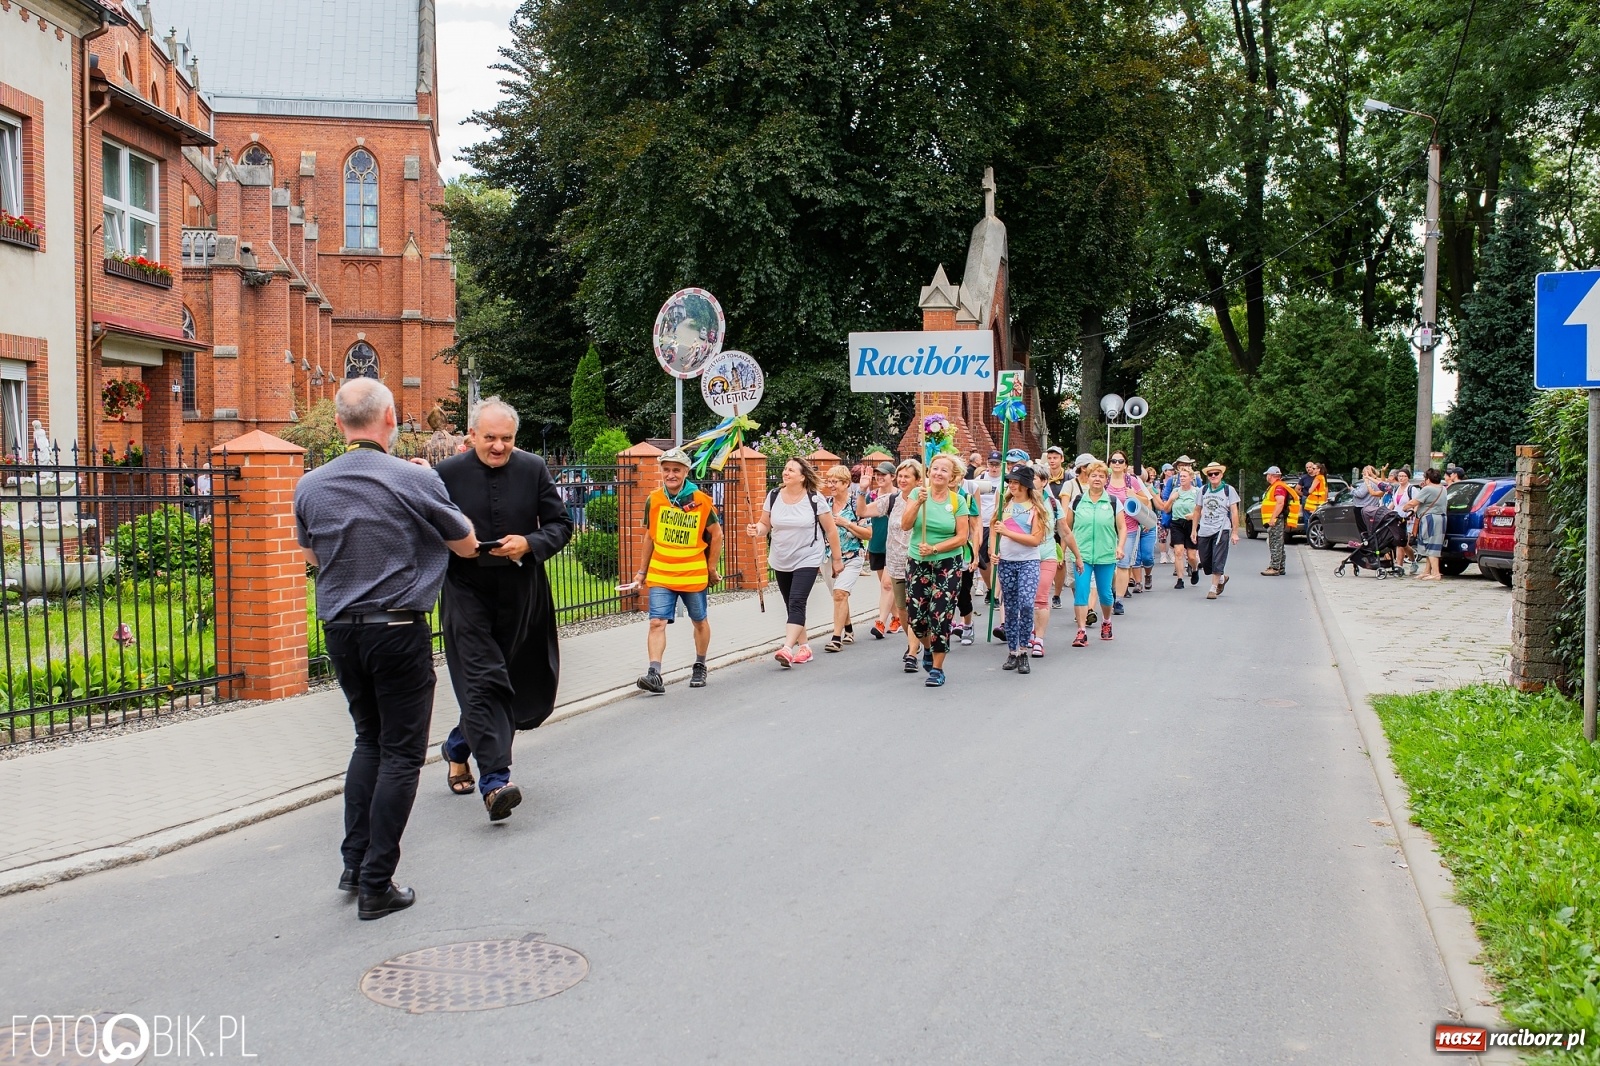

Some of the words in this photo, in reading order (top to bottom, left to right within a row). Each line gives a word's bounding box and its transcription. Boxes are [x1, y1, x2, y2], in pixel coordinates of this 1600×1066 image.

[854, 345, 990, 379] Racibórz
[999, 372, 1015, 396] 5
[712, 390, 757, 406] KIETRZ
[663, 527, 690, 545] RUCHEM
